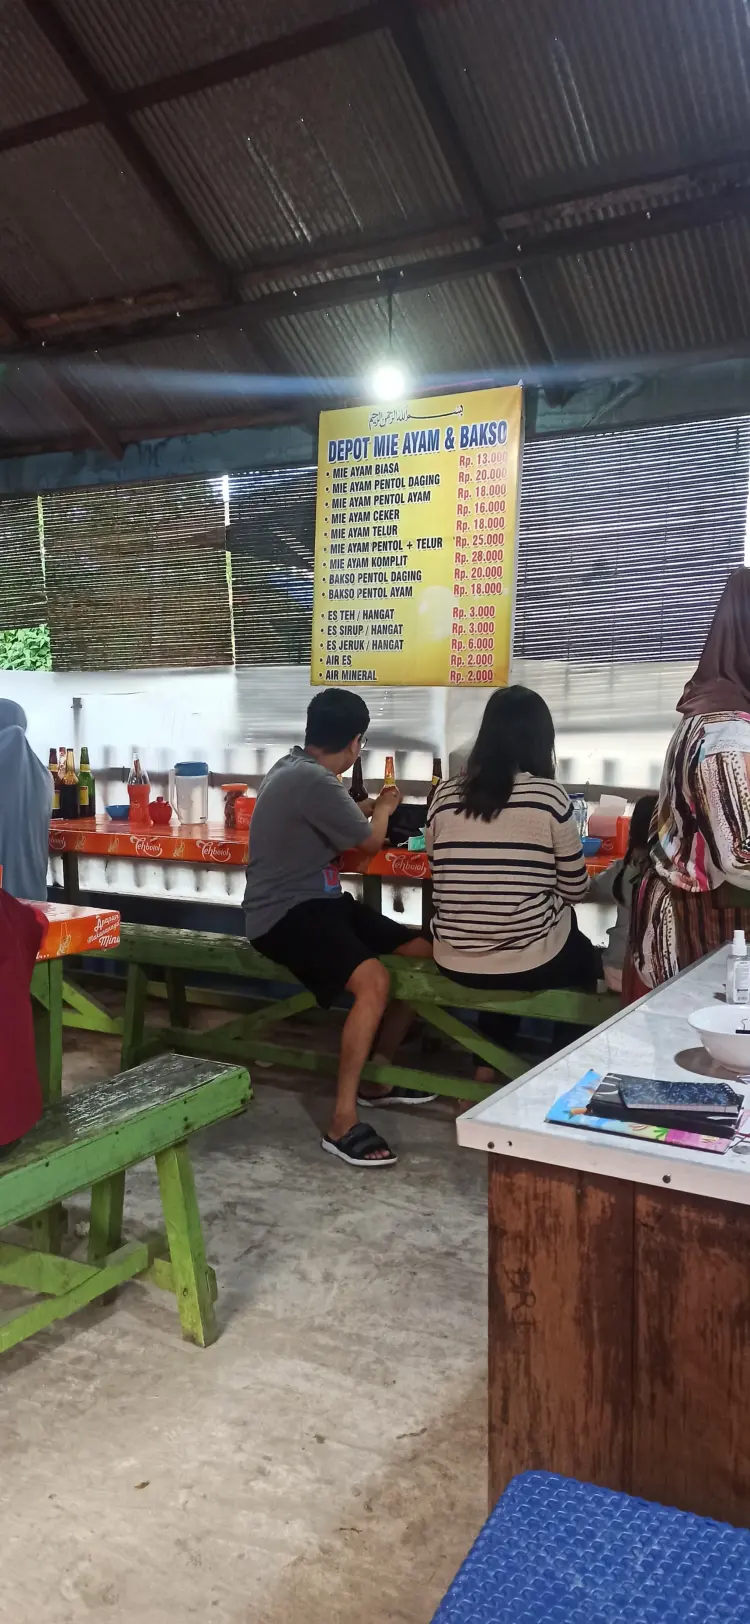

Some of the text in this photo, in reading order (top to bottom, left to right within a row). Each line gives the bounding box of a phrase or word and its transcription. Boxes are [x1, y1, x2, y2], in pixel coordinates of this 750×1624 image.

[328, 420, 508, 463] DEPOT MIE AYAM & BAKSO
[332, 452, 508, 478] MIE AYAM BIASA Rp. 13.000
[332, 468, 507, 494] MIE AYAM PENTOL DAGING Rp. 20.000
[332, 484, 506, 508] MIE AYAM PENTOL AYAM Rp. 18.000
[332, 500, 506, 524] MIE AYAM CEKER Rp. 16.000
[331, 516, 504, 539] MIE AYAM TELUR Rp. 18.000
[330, 533, 504, 554] MIE AYAM PENTOL + TELUR Rp. 25.000
[330, 550, 503, 569] MIE AYAM KOMPLIT Rp. 28.000
[329, 566, 502, 584] BAKSO PENTOL DAGING Rp. 20.000
[328, 582, 502, 600] BAKSO PENTOL AYAM Rp. 18.000
[328, 606, 495, 621] ES TEH / HANGAT Rp. 3.000
[328, 622, 494, 636] ES SIRUP / HANGAT Rp. 3.000
[326, 638, 494, 651] ES JERUK / HANGAT Rp. 6.000
[326, 654, 492, 667] AIR ES Rp. 2.000
[326, 670, 493, 683] AIR MINERAL Rp. 2.000
